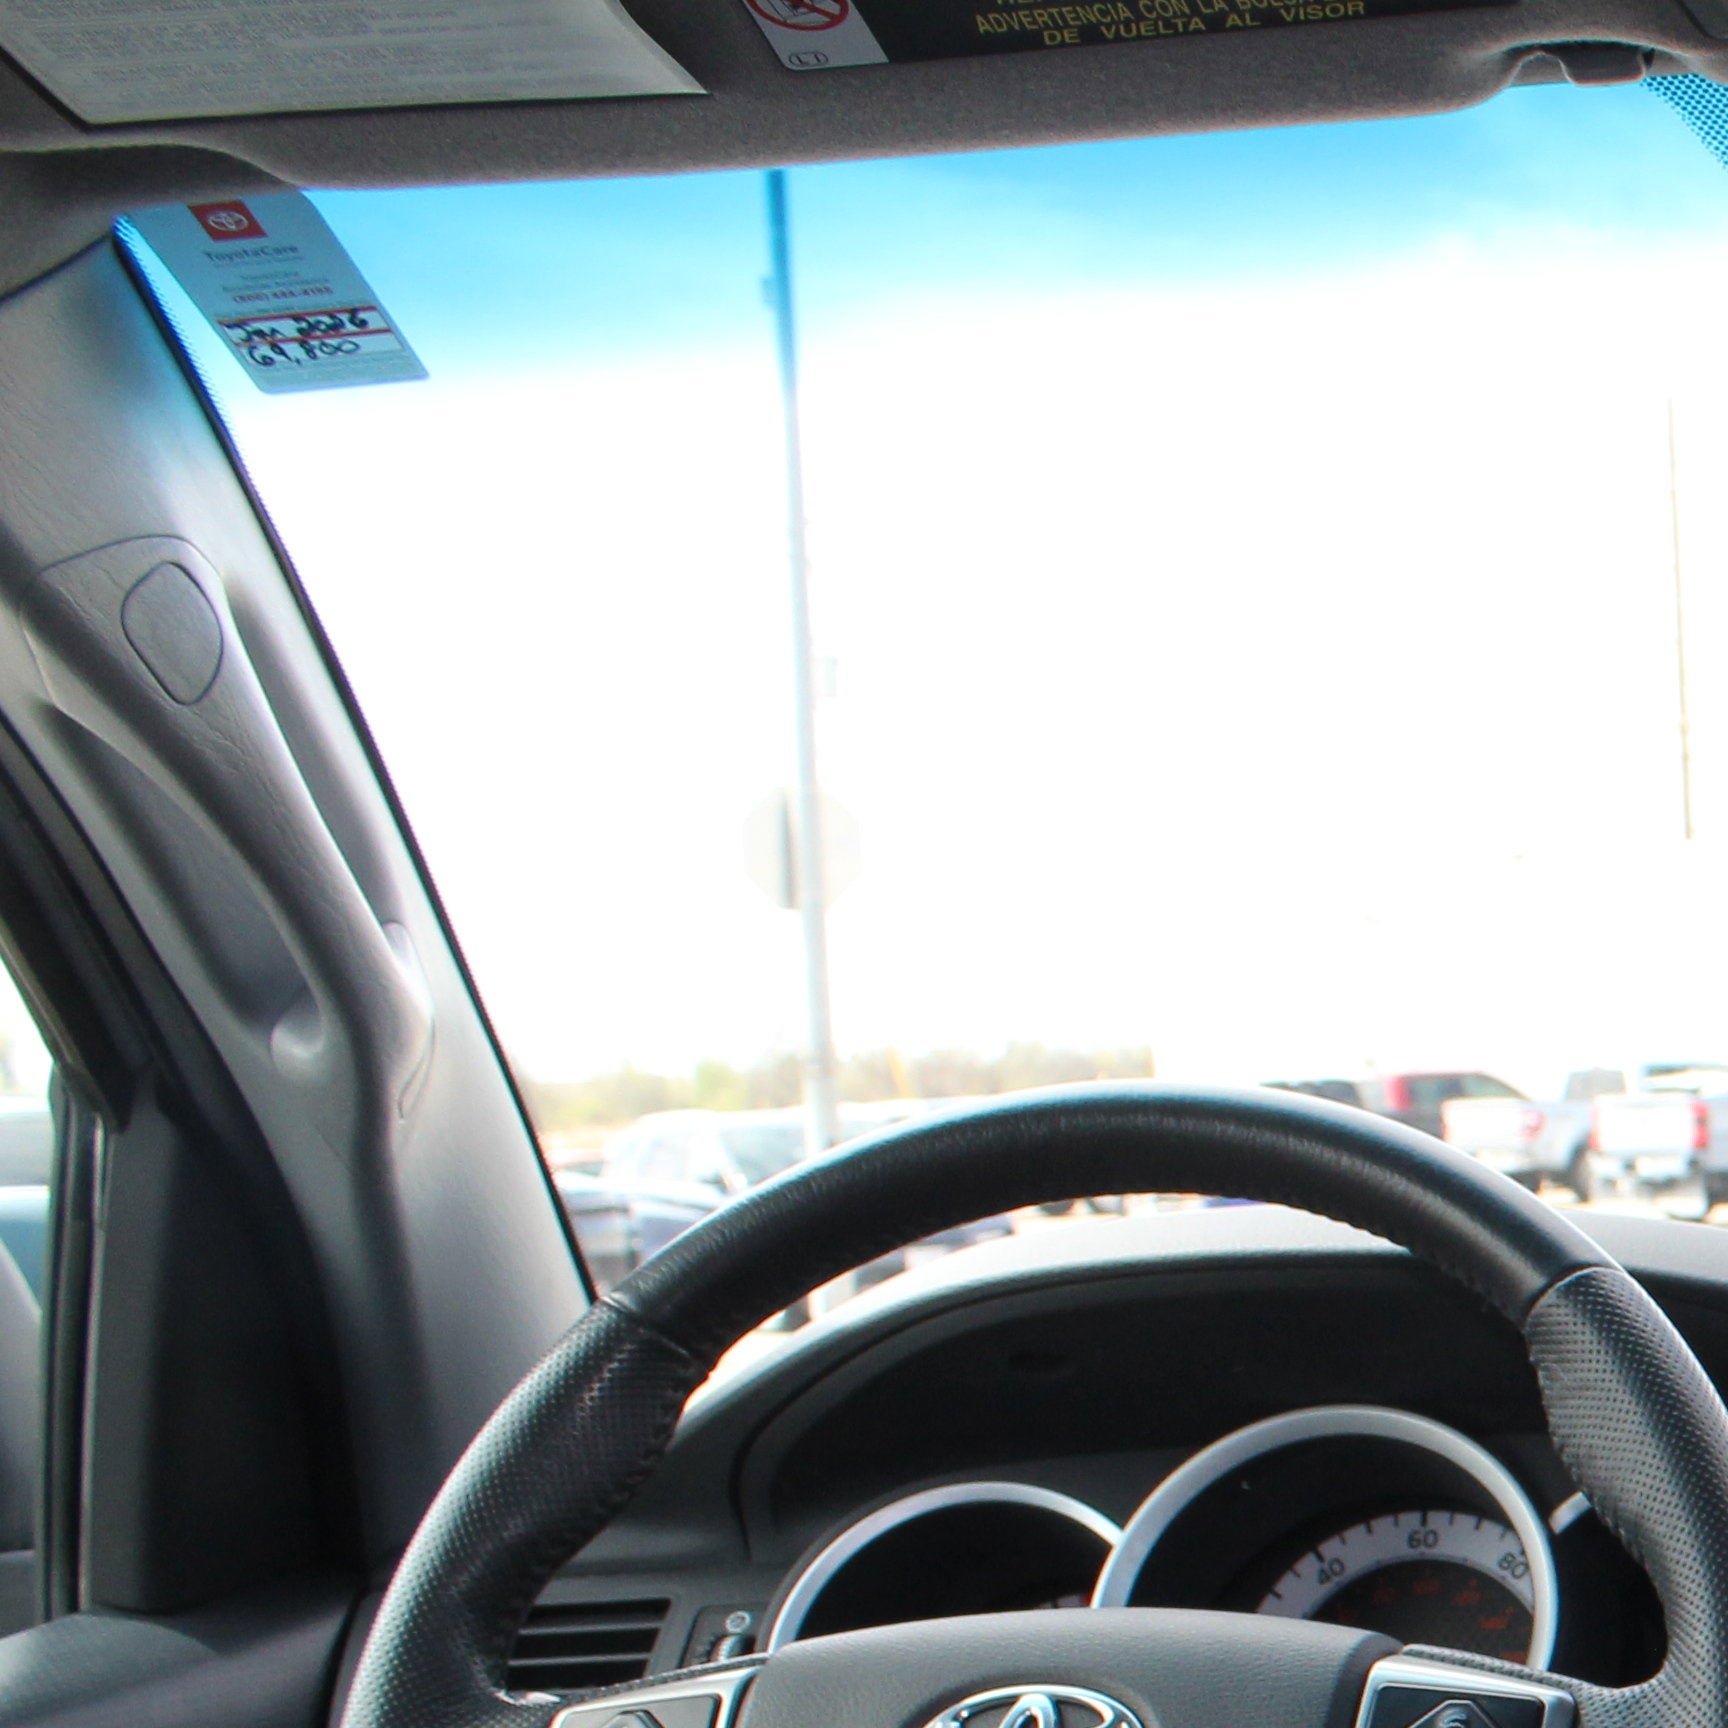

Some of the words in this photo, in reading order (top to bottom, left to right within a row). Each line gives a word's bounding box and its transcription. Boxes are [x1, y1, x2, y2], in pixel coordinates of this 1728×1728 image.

[975, 2, 1133, 35] ADVERTENCIA
[1144, 0, 1191, 18] CON
[1042, 29, 1082, 46] DE
[1101, 17, 1206, 40] VUELTA
[1225, 12, 1261, 28] AL
[1280, 2, 1365, 24] VISOR
[1407, 1529, 1439, 1548] 60
[1318, 1557, 1345, 1585] 40
[1497, 1552, 1529, 1580] 80
